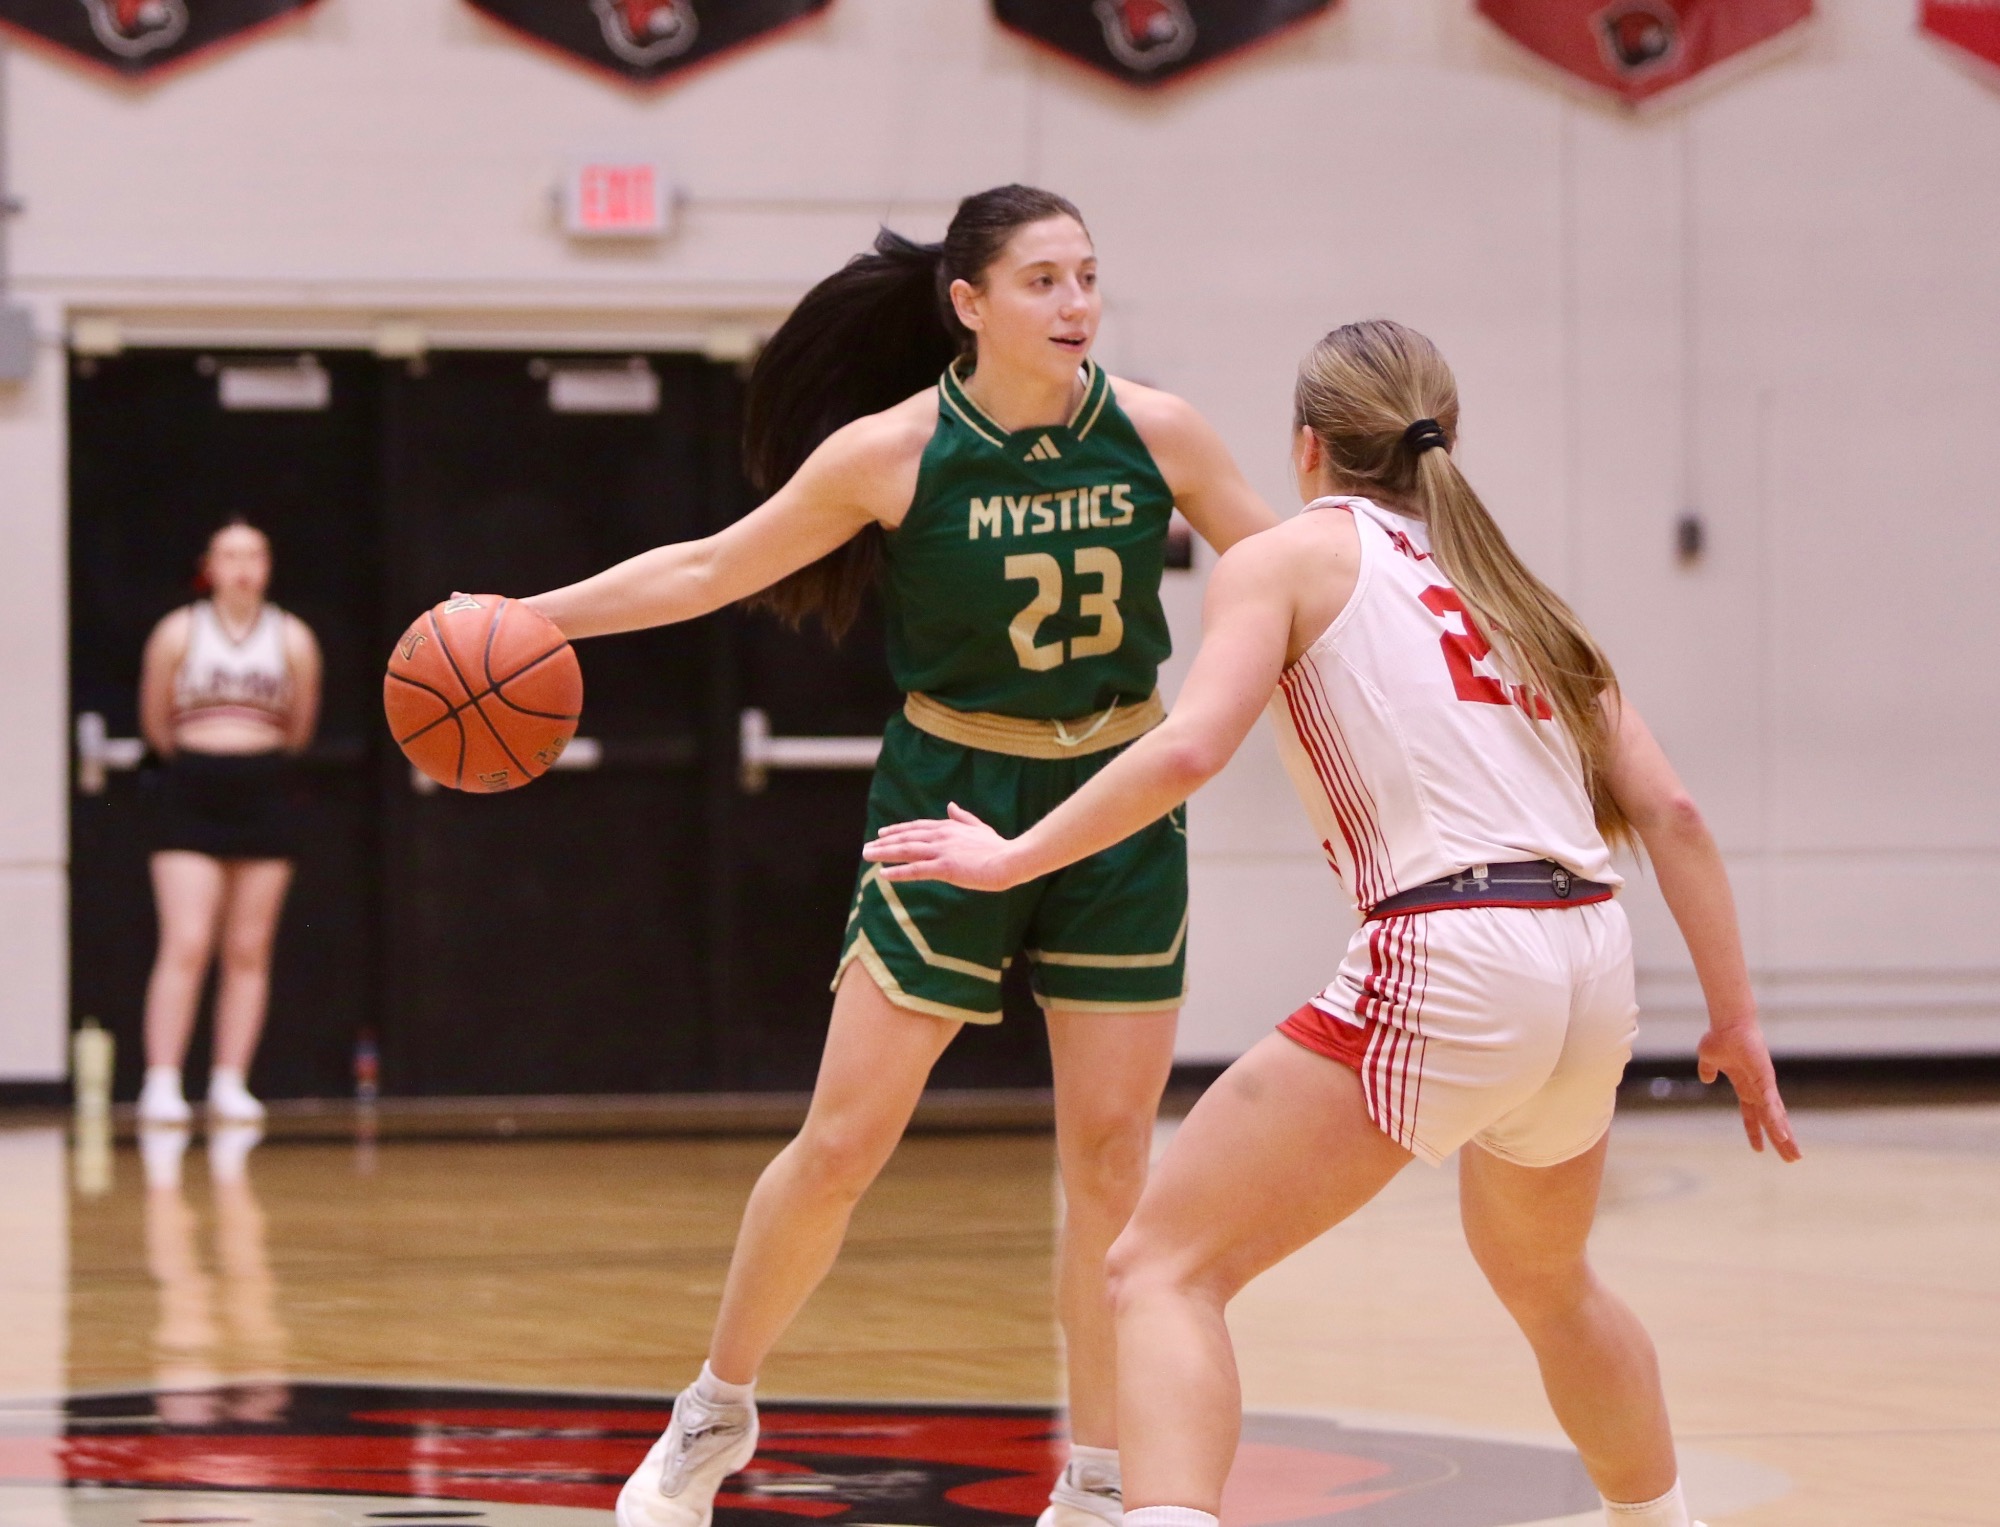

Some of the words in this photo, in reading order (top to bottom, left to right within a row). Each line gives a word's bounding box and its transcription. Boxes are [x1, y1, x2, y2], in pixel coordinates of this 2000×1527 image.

[580, 164, 656, 228] EXIT
[969, 484, 1134, 540] MYSTICS
[1004, 547, 1124, 672] 23
